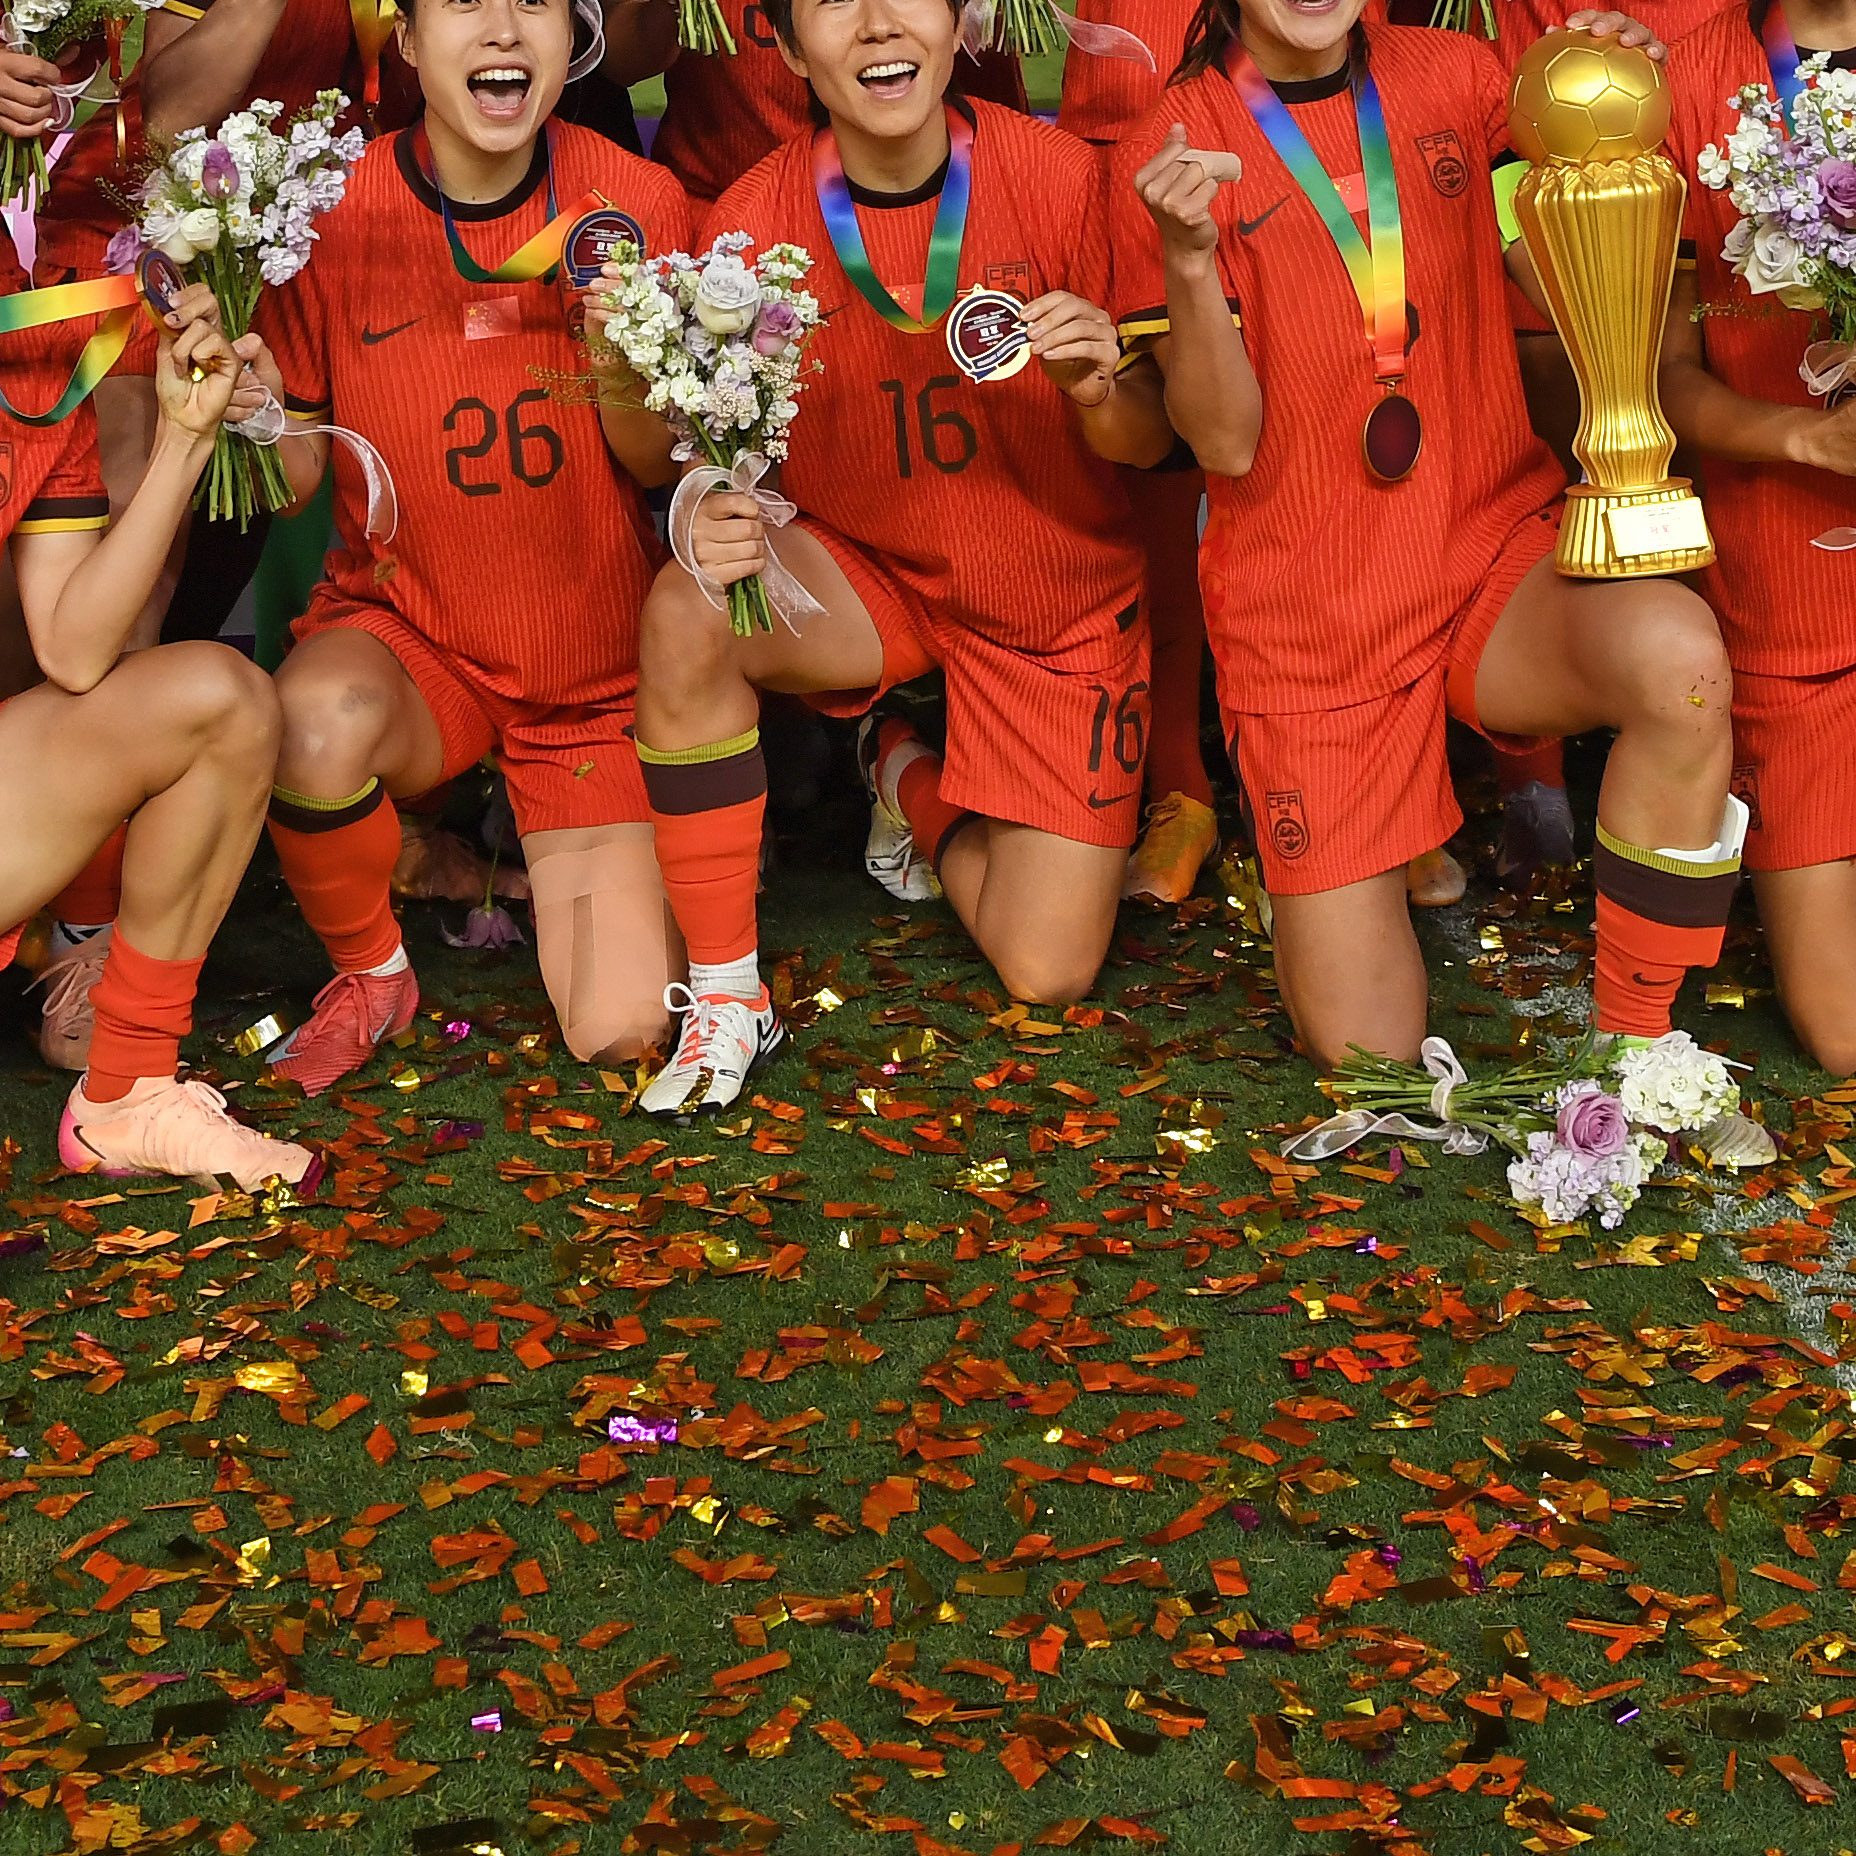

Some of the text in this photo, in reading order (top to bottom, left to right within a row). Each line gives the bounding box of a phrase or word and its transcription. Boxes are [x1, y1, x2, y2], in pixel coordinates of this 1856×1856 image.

[443, 389, 564, 496] 26
[880, 375, 978, 479] 16
[1087, 680, 1149, 773] 16
